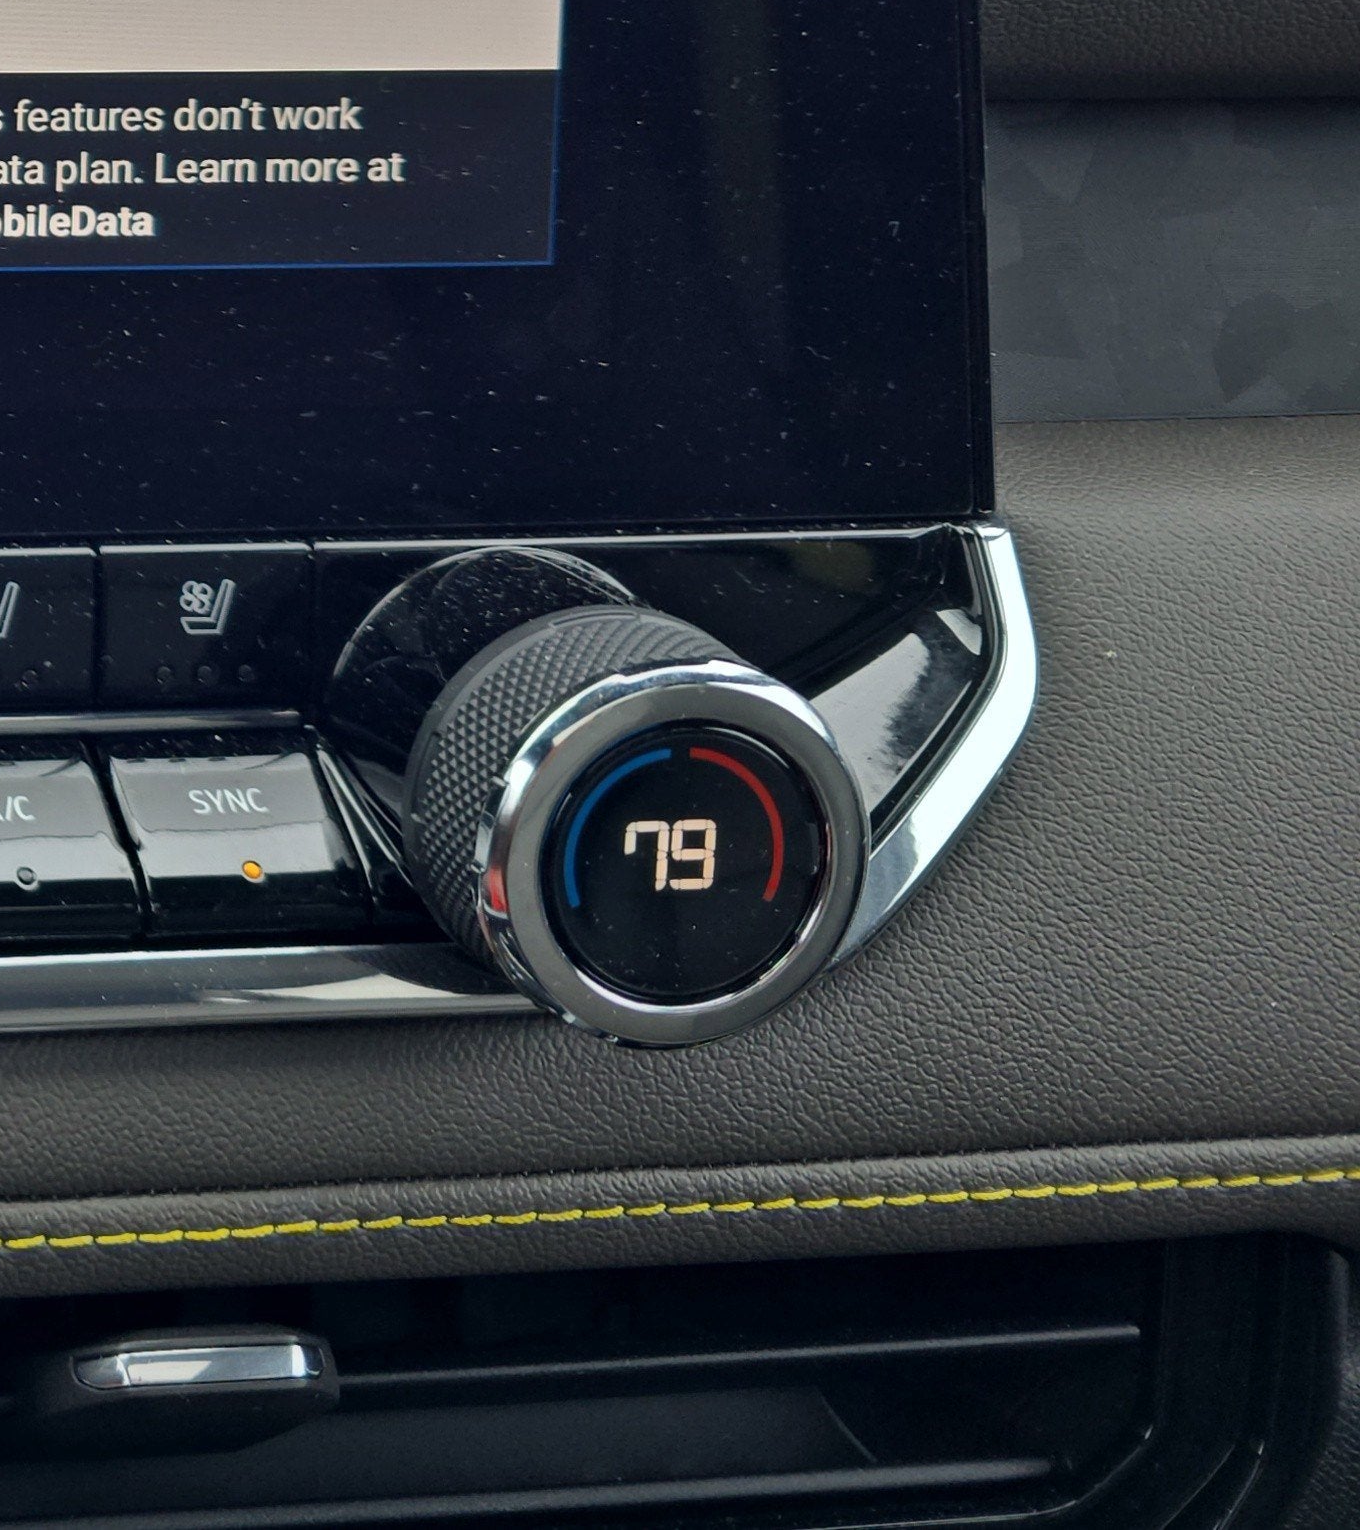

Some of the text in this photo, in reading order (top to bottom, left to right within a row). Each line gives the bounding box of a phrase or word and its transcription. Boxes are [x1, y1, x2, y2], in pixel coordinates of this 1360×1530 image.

[13, 99, 165, 132] features
[273, 97, 363, 131] work
[54, 153, 145, 193] plan.
[155, 152, 257, 184] Learn
[265, 159, 360, 183] more
[368, 155, 404, 183] at
[188, 787, 268, 815] SYNC
[623, 818, 717, 891] 79
